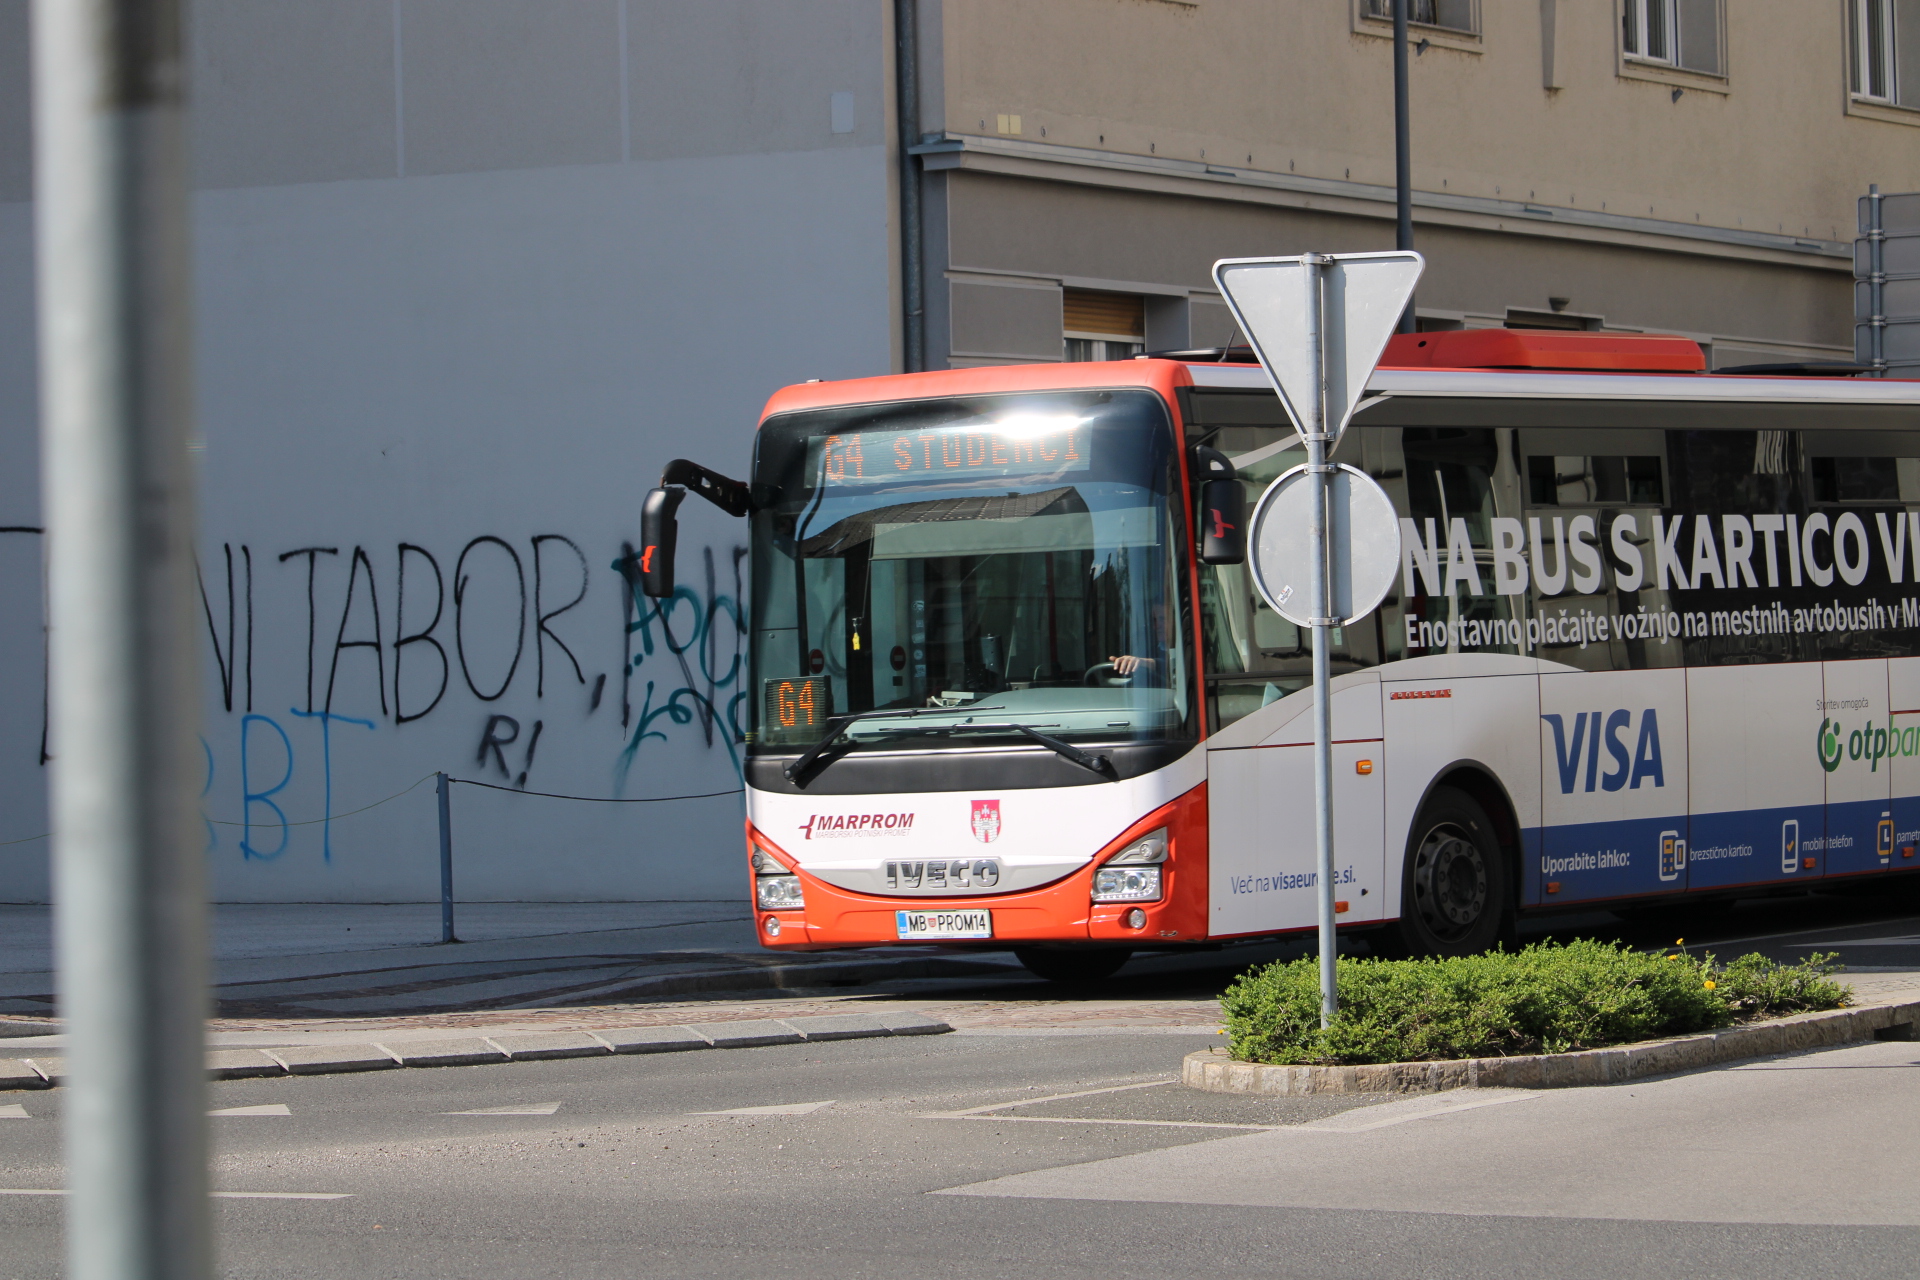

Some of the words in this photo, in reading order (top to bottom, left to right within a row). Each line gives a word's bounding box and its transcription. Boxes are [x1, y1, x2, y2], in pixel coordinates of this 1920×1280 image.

[825, 434, 864, 480] G4
[893, 427, 1080, 470] STUDENCI
[1399, 517, 1484, 597] NA
[1490, 515, 1602, 596] BUS
[1610, 513, 1644, 593] S
[1652, 510, 1870, 591] KARTICO
[1404, 613, 1522, 649] Enostavno
[1526, 609, 1609, 651] plačajte
[1611, 604, 1680, 645] vožnjo
[1683, 611, 1708, 637] na
[1711, 601, 1791, 636] mestnih
[1793, 597, 1886, 634] avtobusih
[1887, 605, 1898, 629] v
[1901, 597, 1920, 628] M
[778, 680, 814, 727] G4
[1816, 698, 1841, 711] Storitev
[1841, 697, 1869, 711] omogoča
[1540, 708, 1665, 795] VISA
[817, 813, 914, 830] MARPROM
[1690, 845, 1728, 861] brezstično
[1728, 843, 1753, 857] kartico
[1829, 834, 1853, 849] telefon
[887, 860, 999, 889] IVECO
[1541, 852, 1596, 876] Uporabite
[1597, 849, 1630, 868] lahko:
[1231, 875, 1253, 895] Več
[1255, 877, 1270, 892] na
[1272, 865, 1356, 891] visaeure.si.
[908, 915, 927, 932] MB
[937, 914, 986, 932] PROM14
